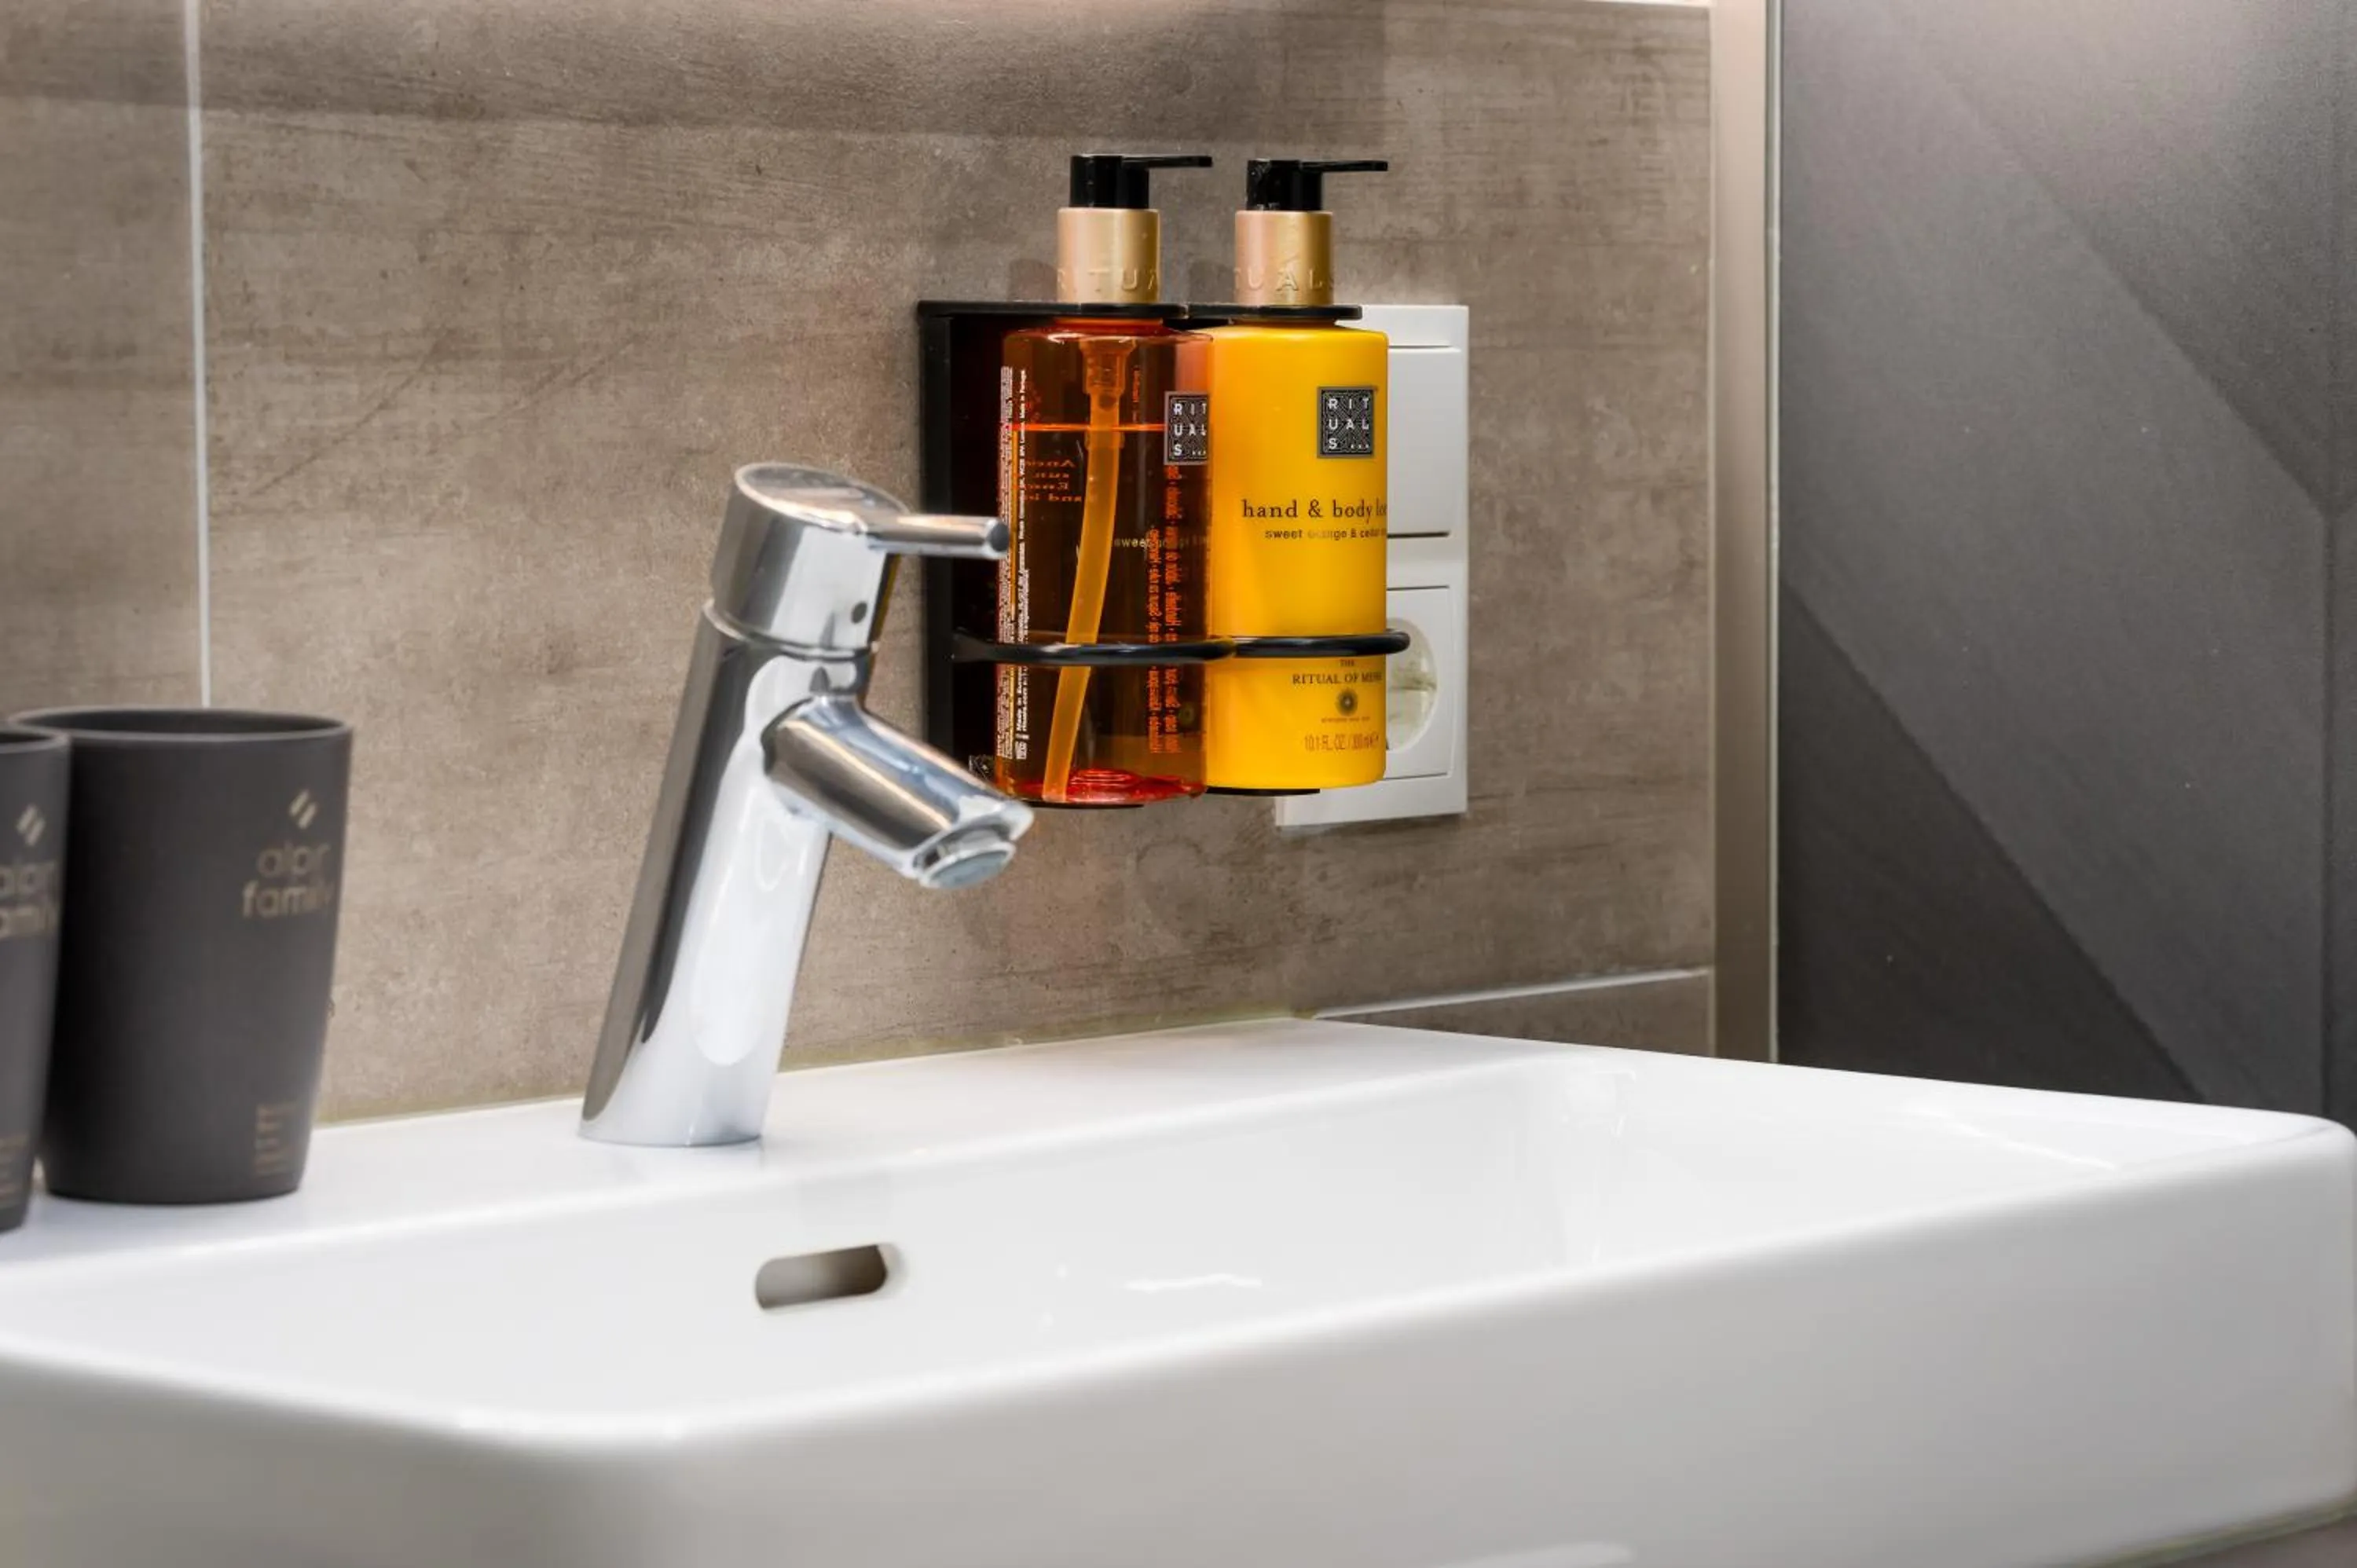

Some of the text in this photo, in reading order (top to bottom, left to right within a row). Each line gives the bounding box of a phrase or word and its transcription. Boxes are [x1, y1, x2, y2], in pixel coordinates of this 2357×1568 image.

[1241, 499, 1299, 518] hand
[1308, 498, 1324, 518] &
[1332, 498, 1373, 524] body
[1265, 529, 1303, 540] sweet
[1292, 673, 1342, 684] RITUAL
[1344, 672, 1359, 683] OF
